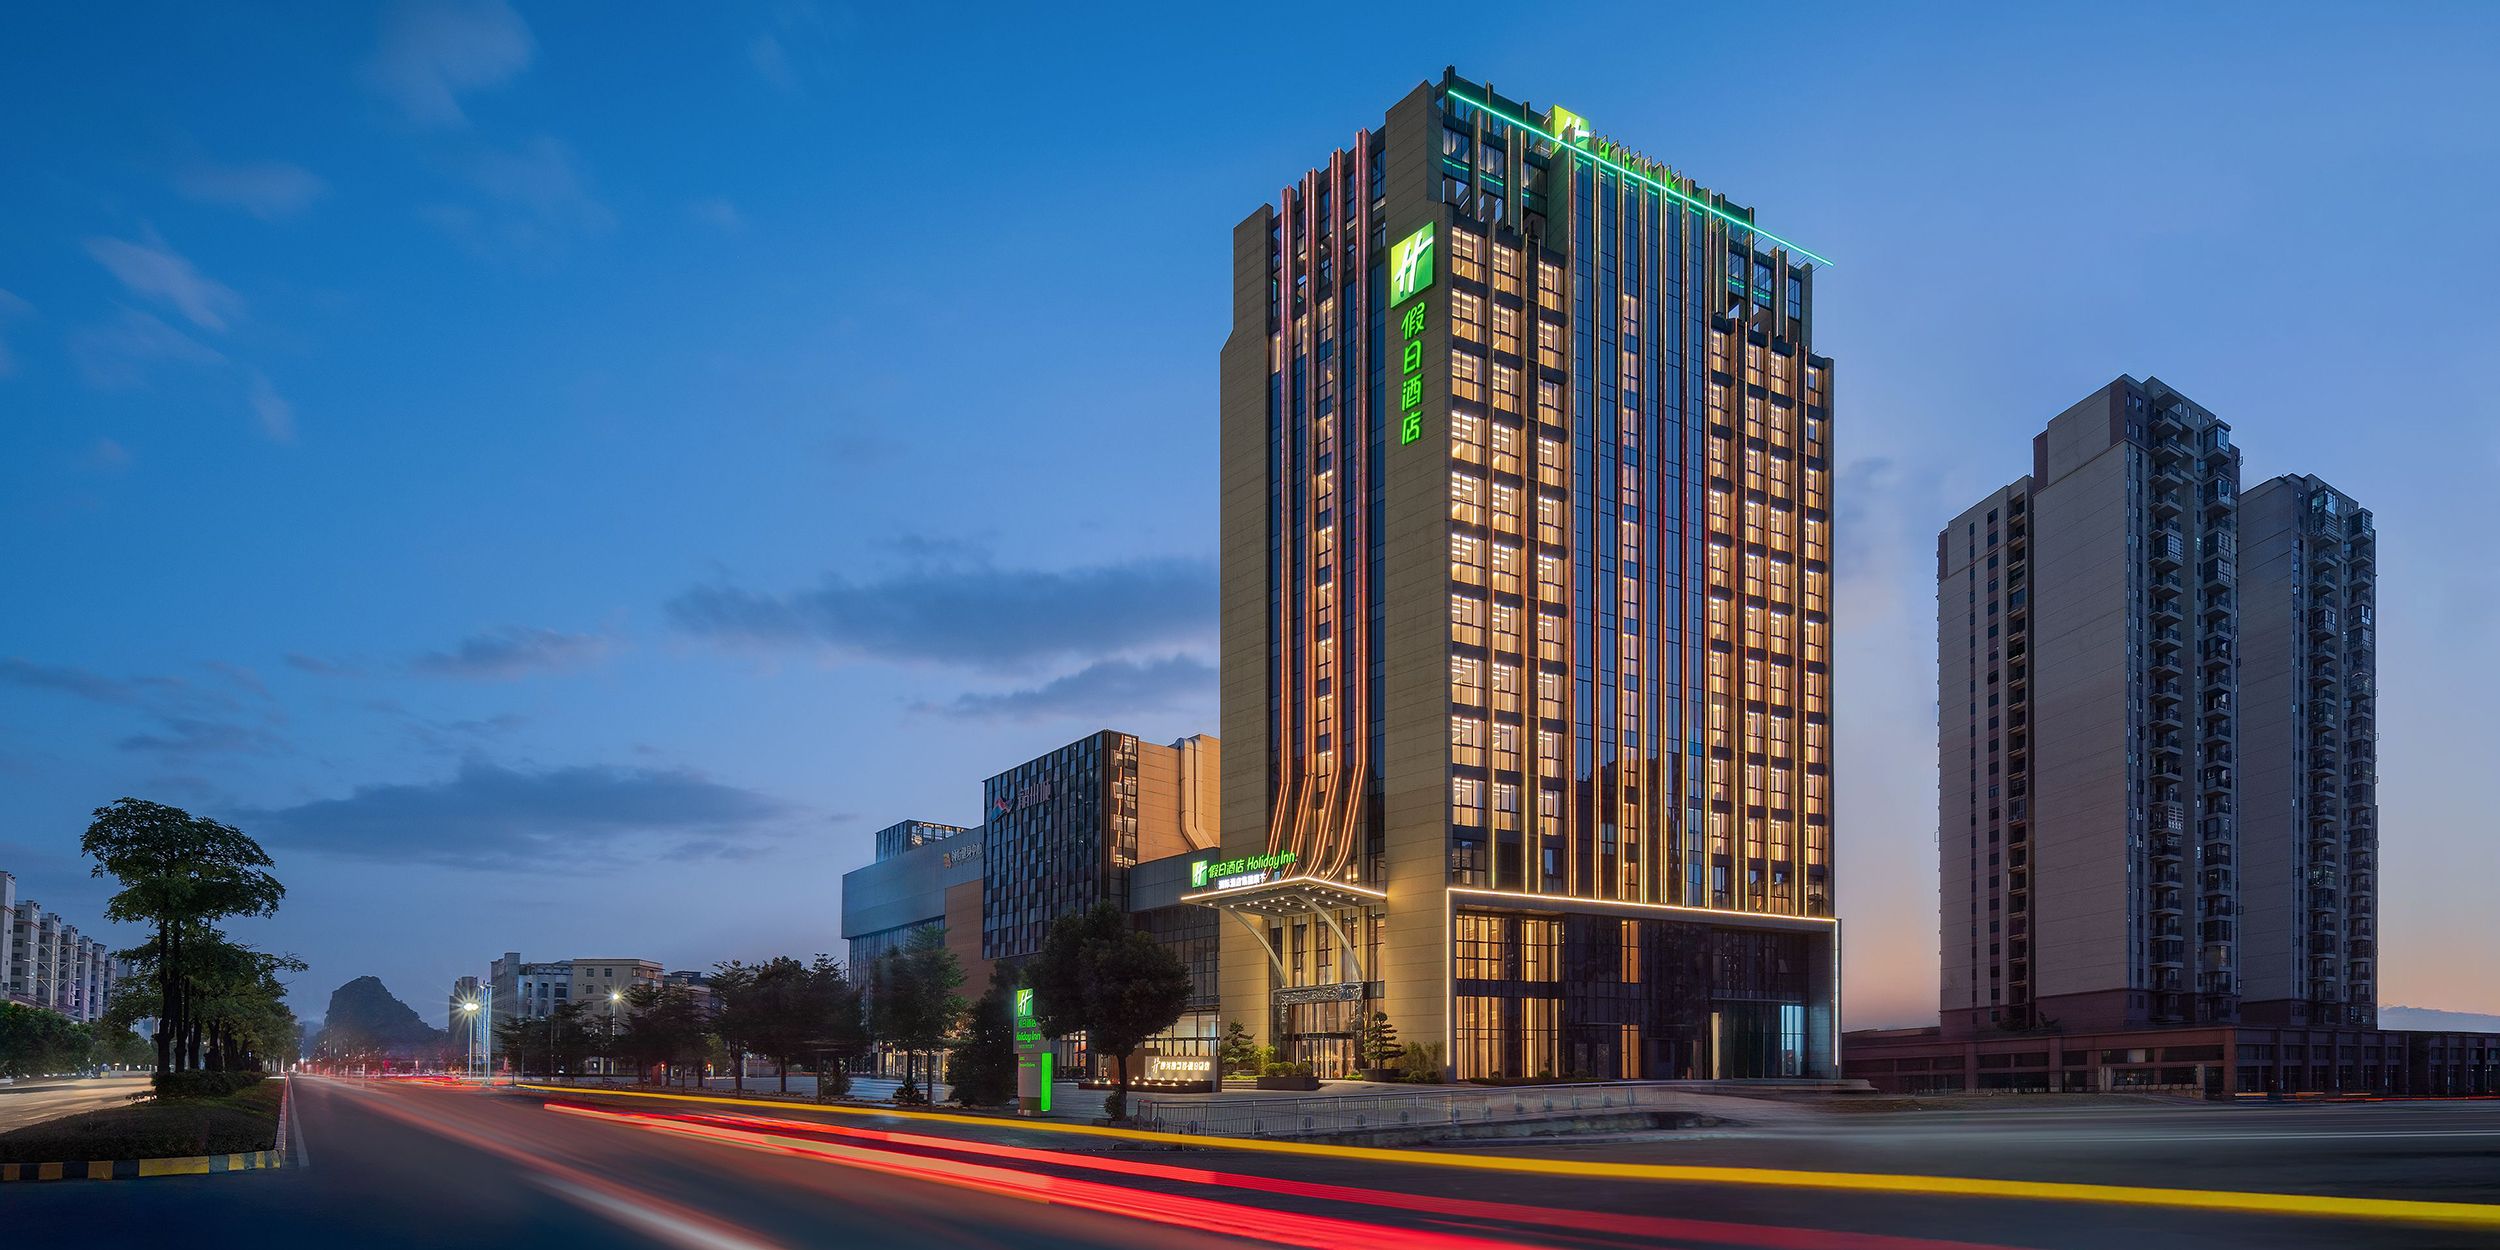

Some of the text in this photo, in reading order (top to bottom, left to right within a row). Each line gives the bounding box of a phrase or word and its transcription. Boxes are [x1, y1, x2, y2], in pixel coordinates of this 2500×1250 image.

[1401, 302, 1426, 446] 假日酒店
[1208, 859, 1245, 878] 假日酒店
[1247, 850, 1295, 871] Holiday Inn
